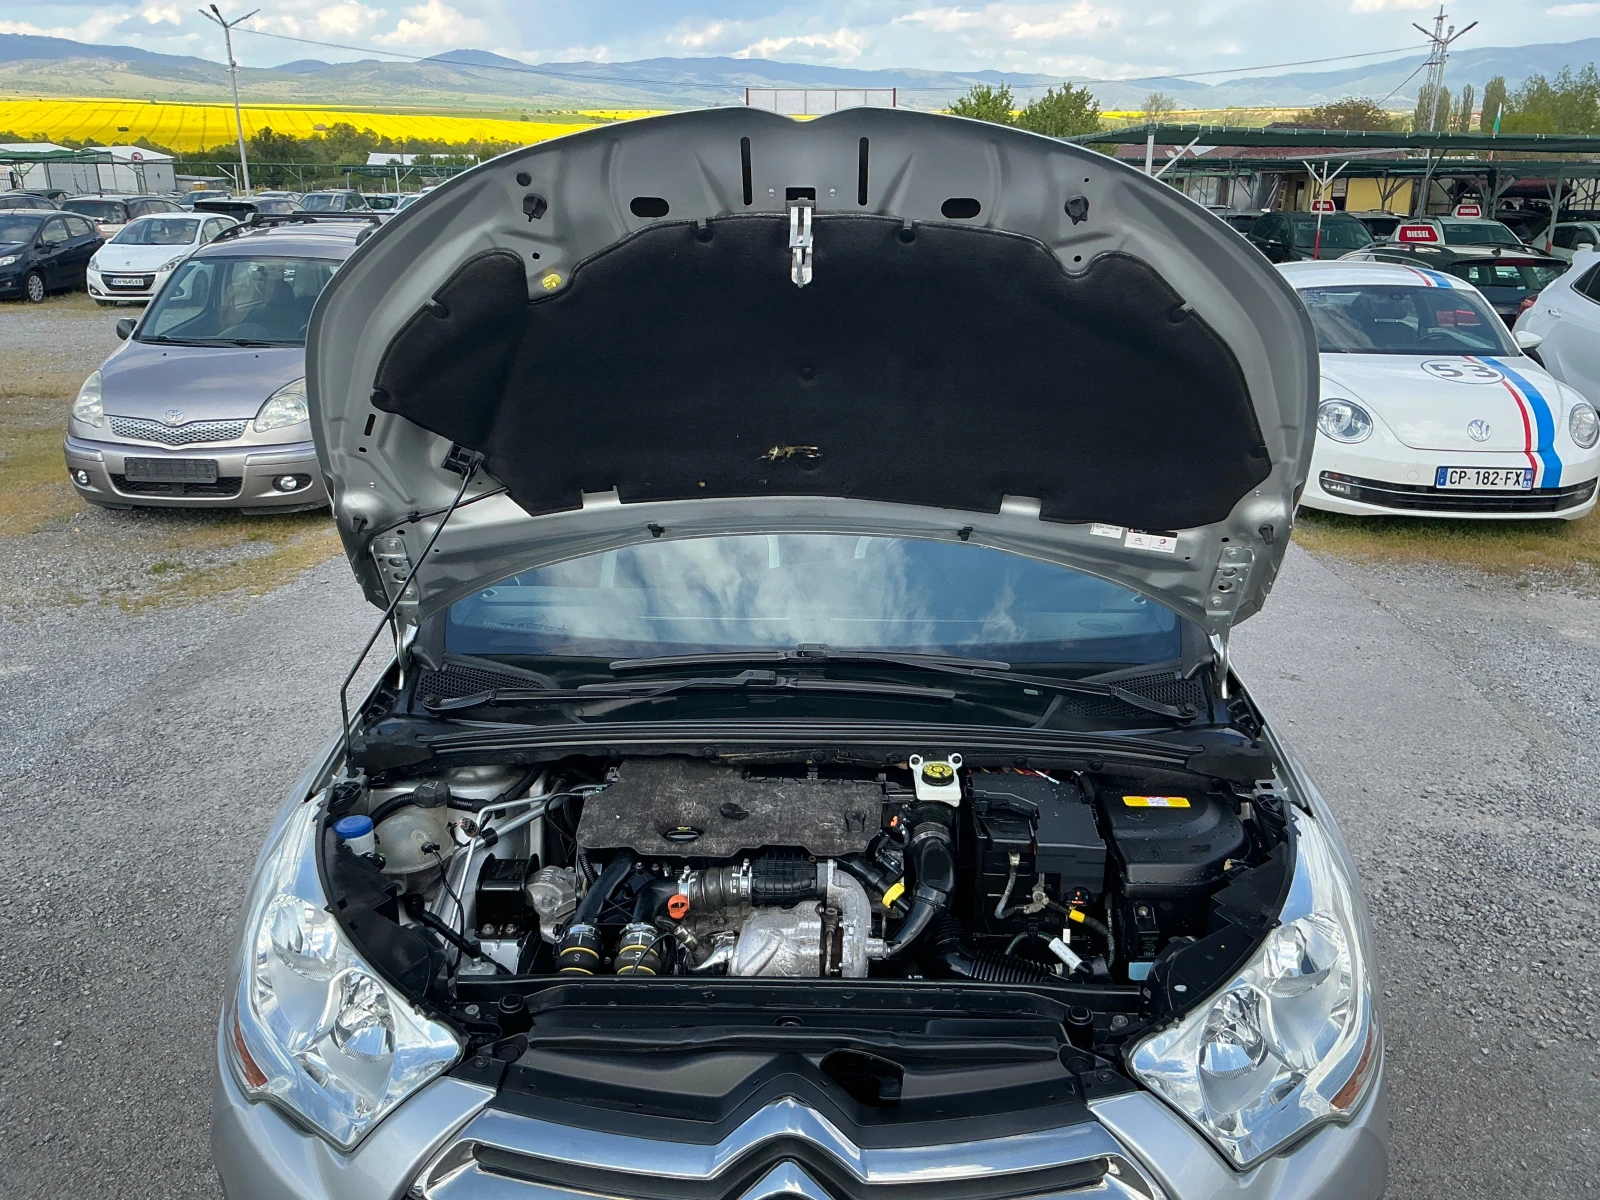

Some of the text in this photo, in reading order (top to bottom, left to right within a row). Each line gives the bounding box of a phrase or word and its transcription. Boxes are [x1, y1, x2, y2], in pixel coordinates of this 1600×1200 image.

[1406, 230, 1430, 238] DIESEL
[1428, 364, 1498, 378] 53
[1449, 470, 1522, 486] CP-182-FX
[1522, 480, 1531, 488] 83
